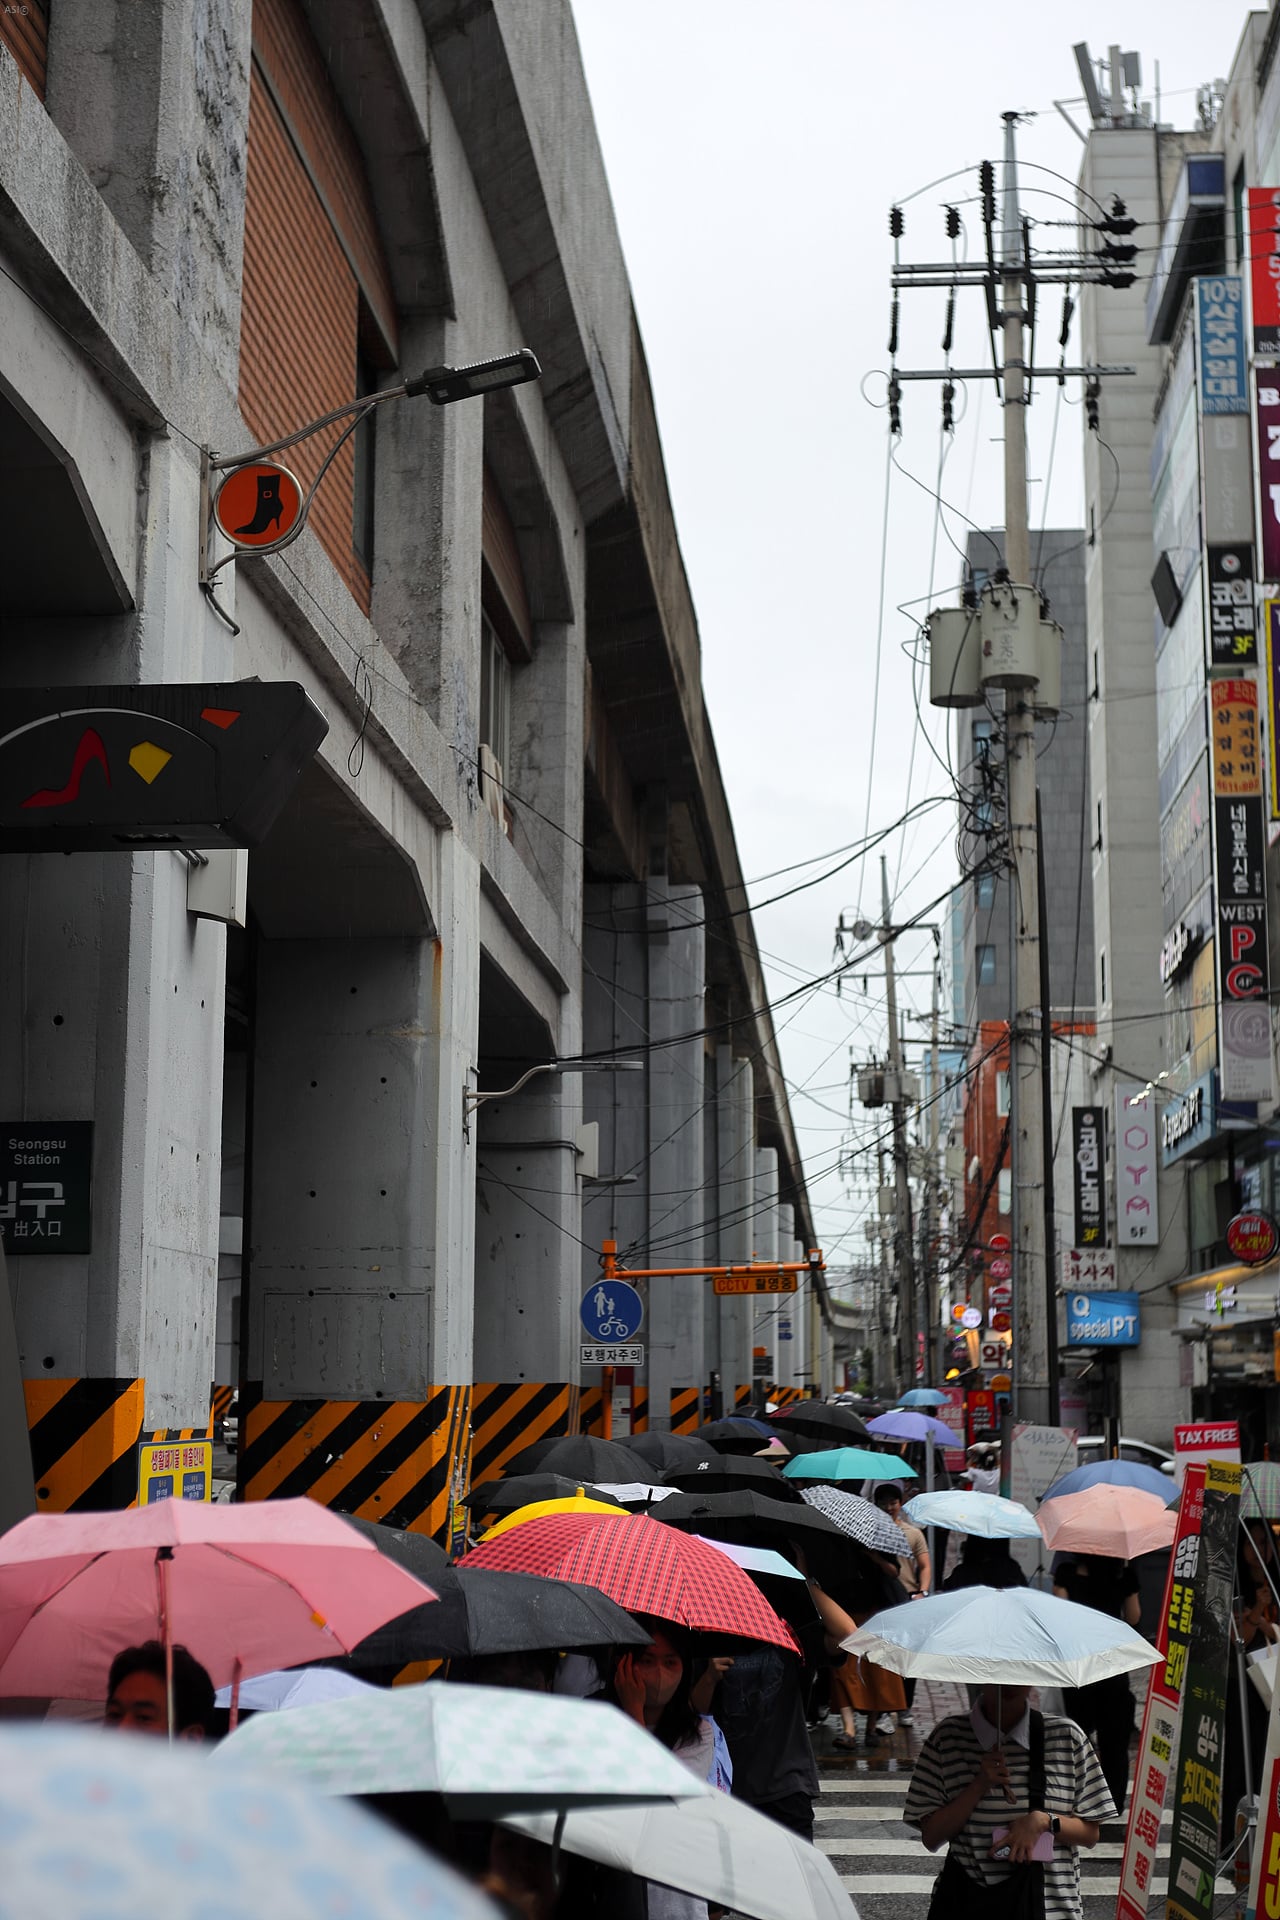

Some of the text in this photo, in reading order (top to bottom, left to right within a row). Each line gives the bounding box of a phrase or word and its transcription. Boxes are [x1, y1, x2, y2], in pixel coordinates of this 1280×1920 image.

[1201, 279, 1241, 302] 10평
[1233, 635, 1254, 655] 3F
[1229, 803, 1249, 894] 네일포시즌
[1220, 905, 1264, 921] WEST
[8, 1138, 67, 1151] Seongsu
[14, 1153, 60, 1165] Station
[14, 1220, 62, 1237] 出入口
[1082, 1227, 1099, 1242] 3F
[1130, 1226, 1147, 1238] 5F
[717, 1277, 793, 1292] CCTV 촬영중
[1072, 1294, 1091, 1318] Q
[583, 1348, 641, 1362] 보행자주의
[982, 1344, 1006, 1368] 약
[1177, 1427, 1238, 1445] TAX FREE
[1197, 1713, 1219, 1764] 성수
[1180, 1869, 1198, 1888] PRIME
